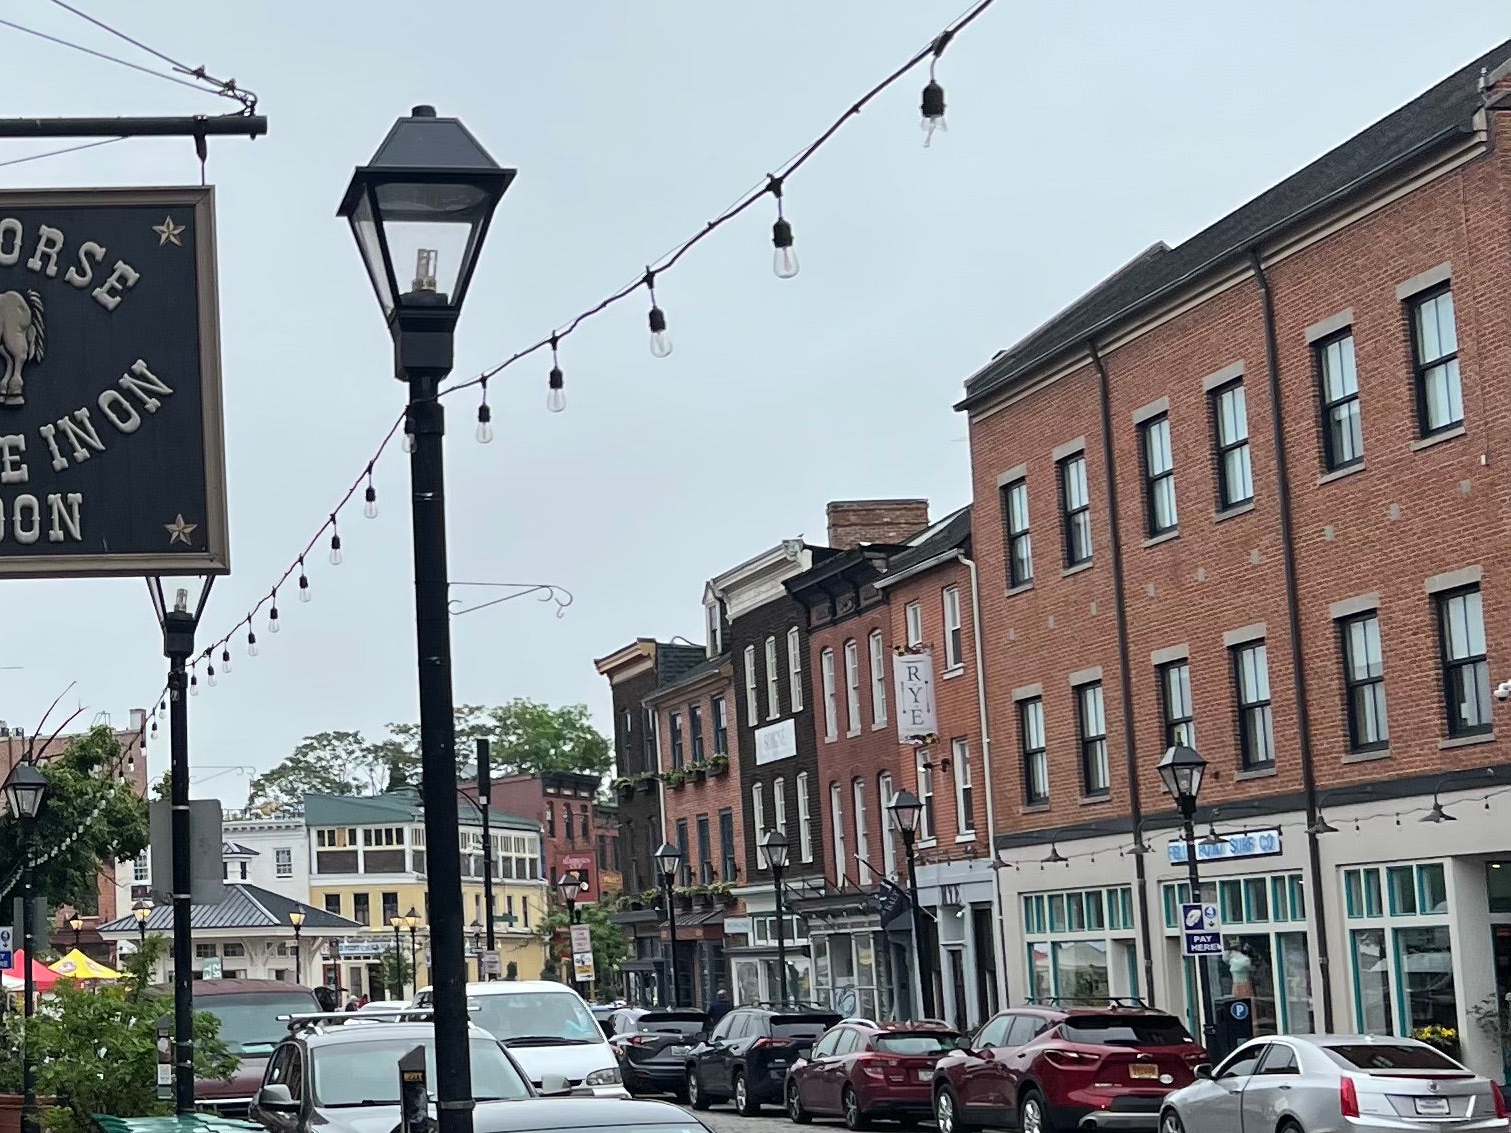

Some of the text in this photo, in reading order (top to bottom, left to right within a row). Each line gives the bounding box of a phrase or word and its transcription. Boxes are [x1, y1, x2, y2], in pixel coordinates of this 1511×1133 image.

[39, 407, 106, 472] IN
[98, 358, 174, 434] ON
[906, 665, 925, 725] RYE
[1191, 944, 1217, 952] HERE
[1193, 935, 1212, 943] PAY
